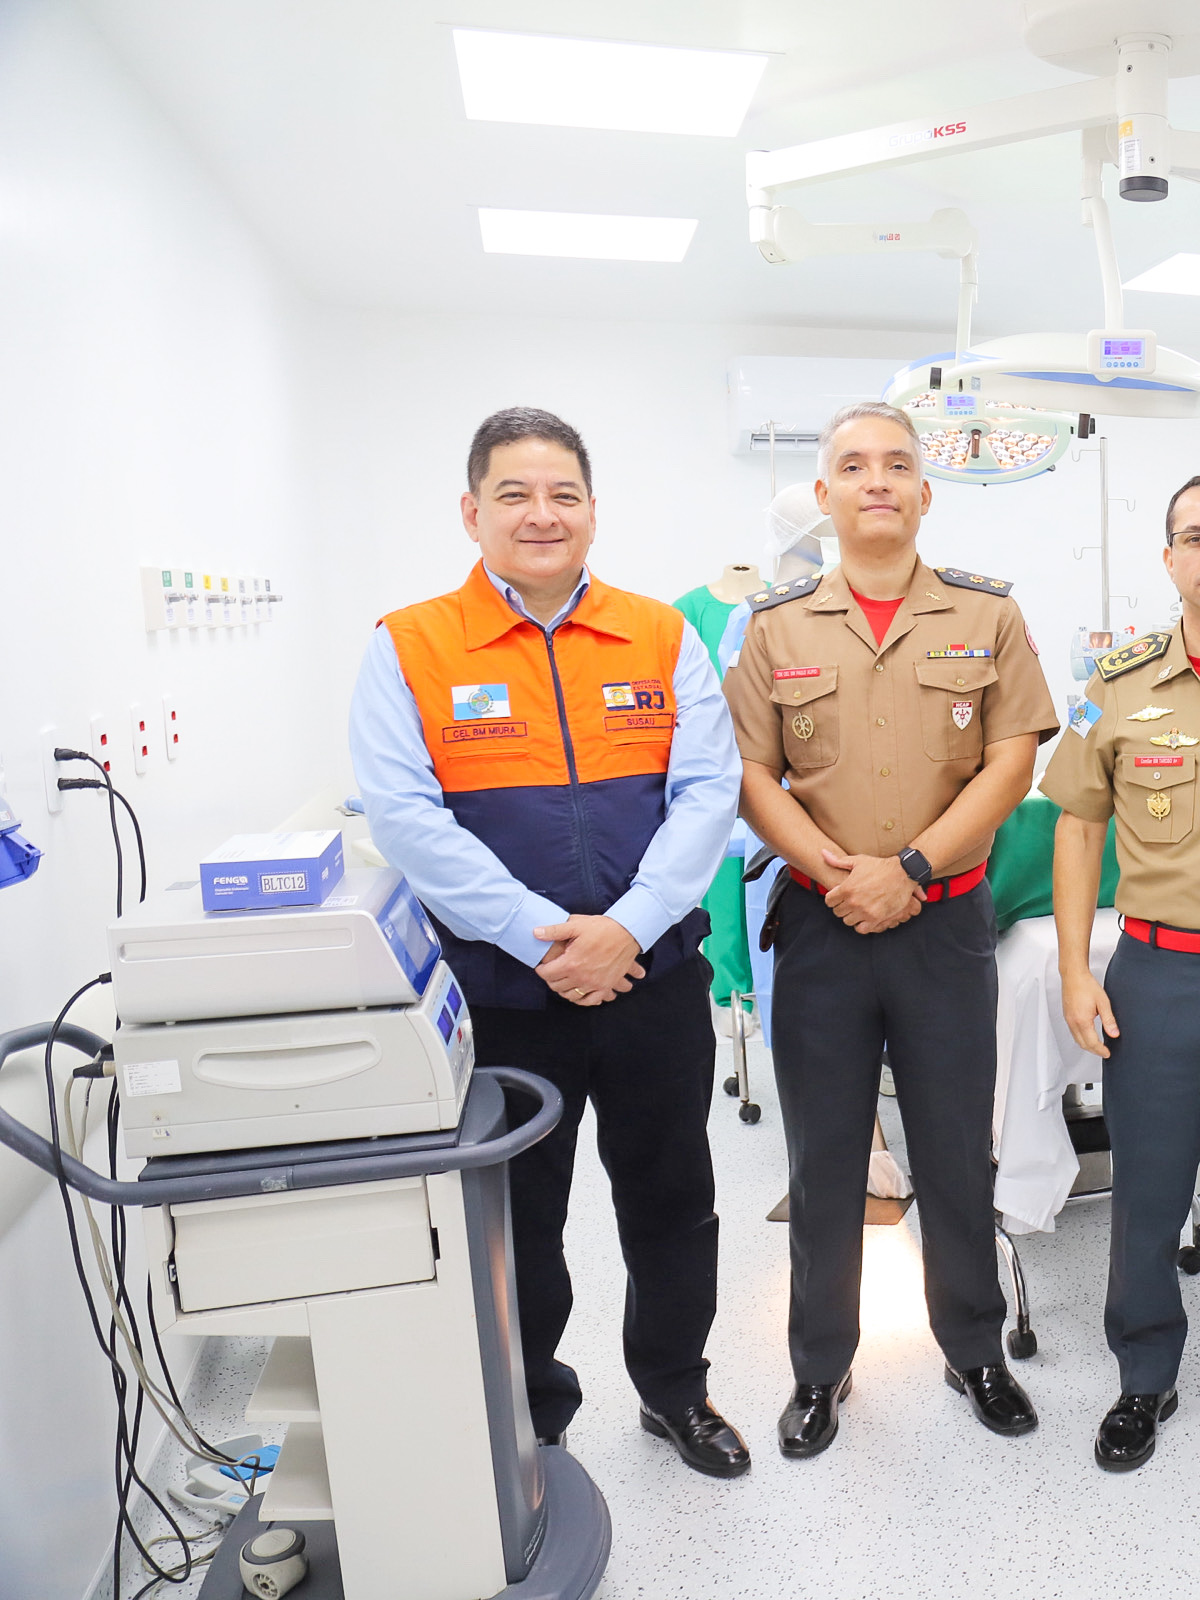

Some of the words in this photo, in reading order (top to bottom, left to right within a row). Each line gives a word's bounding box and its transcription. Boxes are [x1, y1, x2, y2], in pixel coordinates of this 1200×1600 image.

[888, 121, 967, 147] GrupoKSS
[635, 691, 665, 710] RJ
[453, 729, 471, 739] CEL
[473, 728, 486, 737] BM
[489, 726, 517, 735] MIURA
[262, 876, 304, 892] BLTC12
